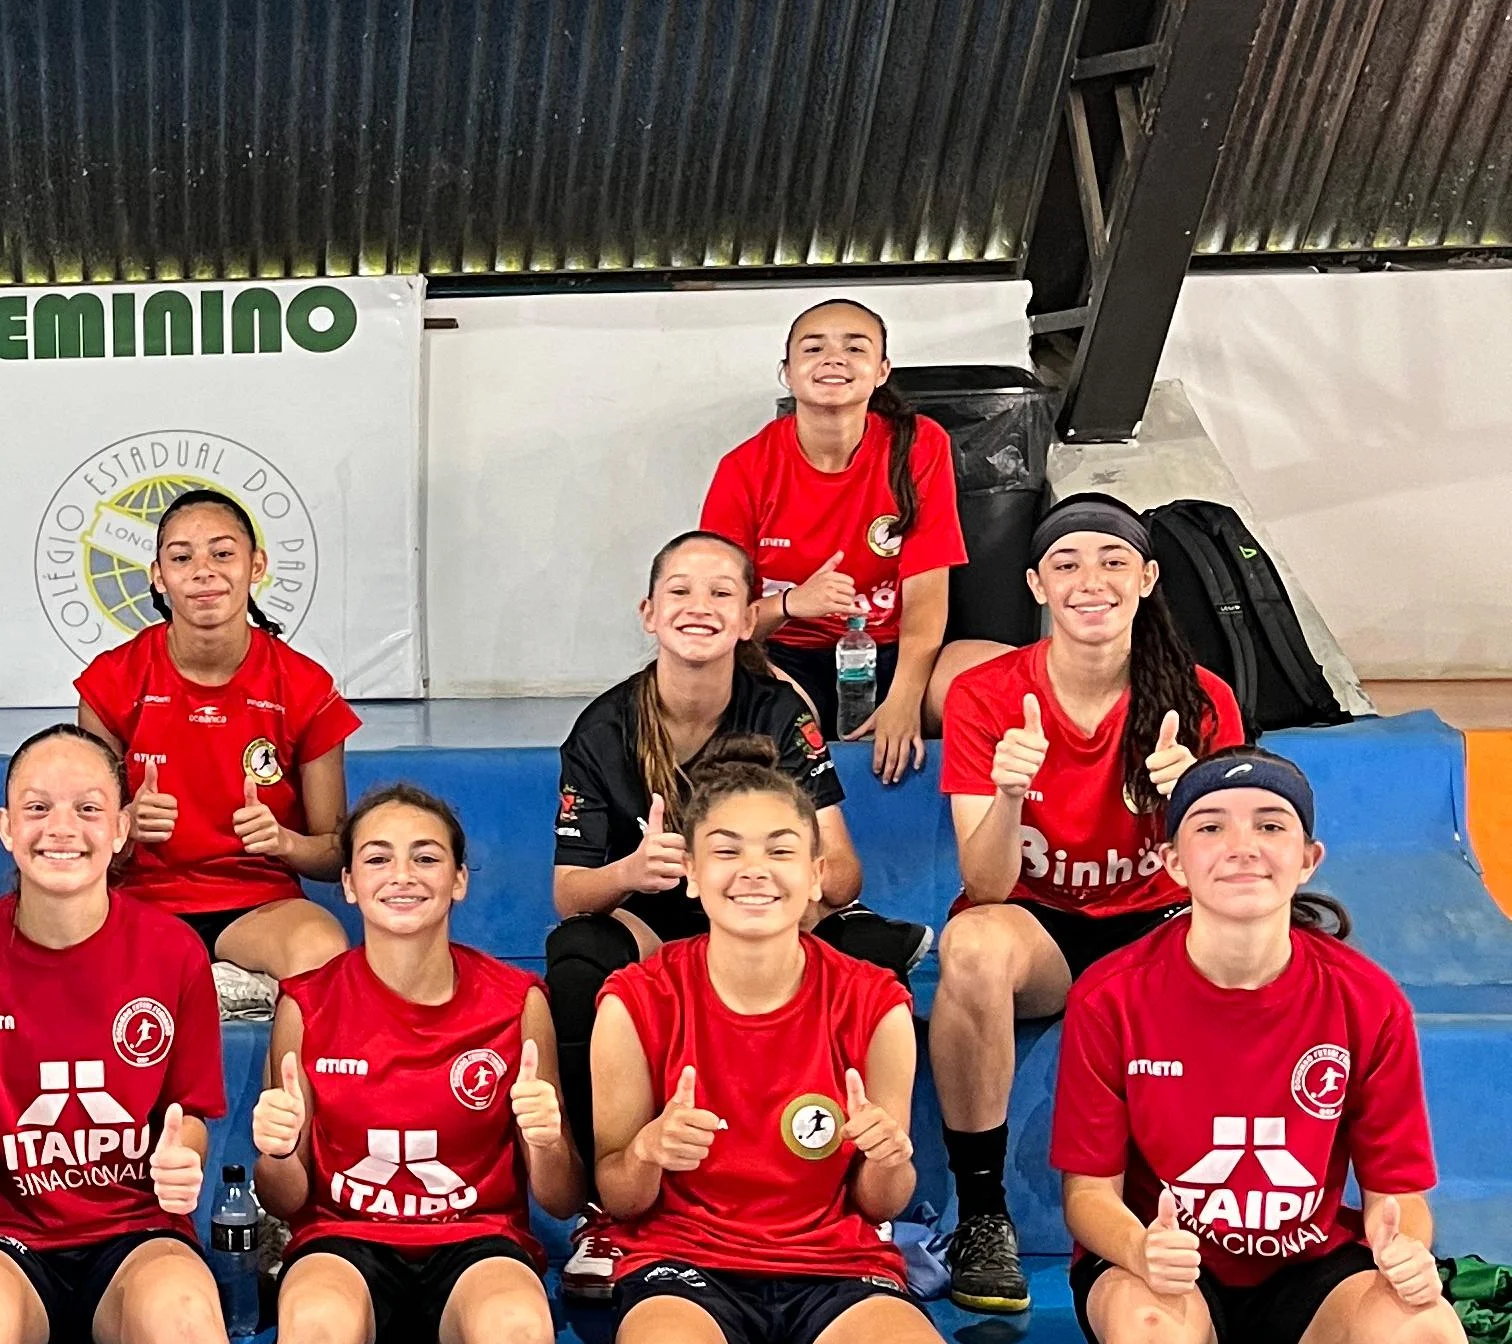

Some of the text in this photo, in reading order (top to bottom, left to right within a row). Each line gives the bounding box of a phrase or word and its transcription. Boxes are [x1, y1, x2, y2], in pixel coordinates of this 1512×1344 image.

[84, 440, 291, 519] ESTADUAL DO
[104, 523, 157, 552] LONG
[42, 504, 101, 644] COLÉGIO
[315, 1057, 369, 1076] ATLETA
[1127, 1058, 1184, 1077] ATLETA
[2, 1123, 151, 1171] ITAIPU
